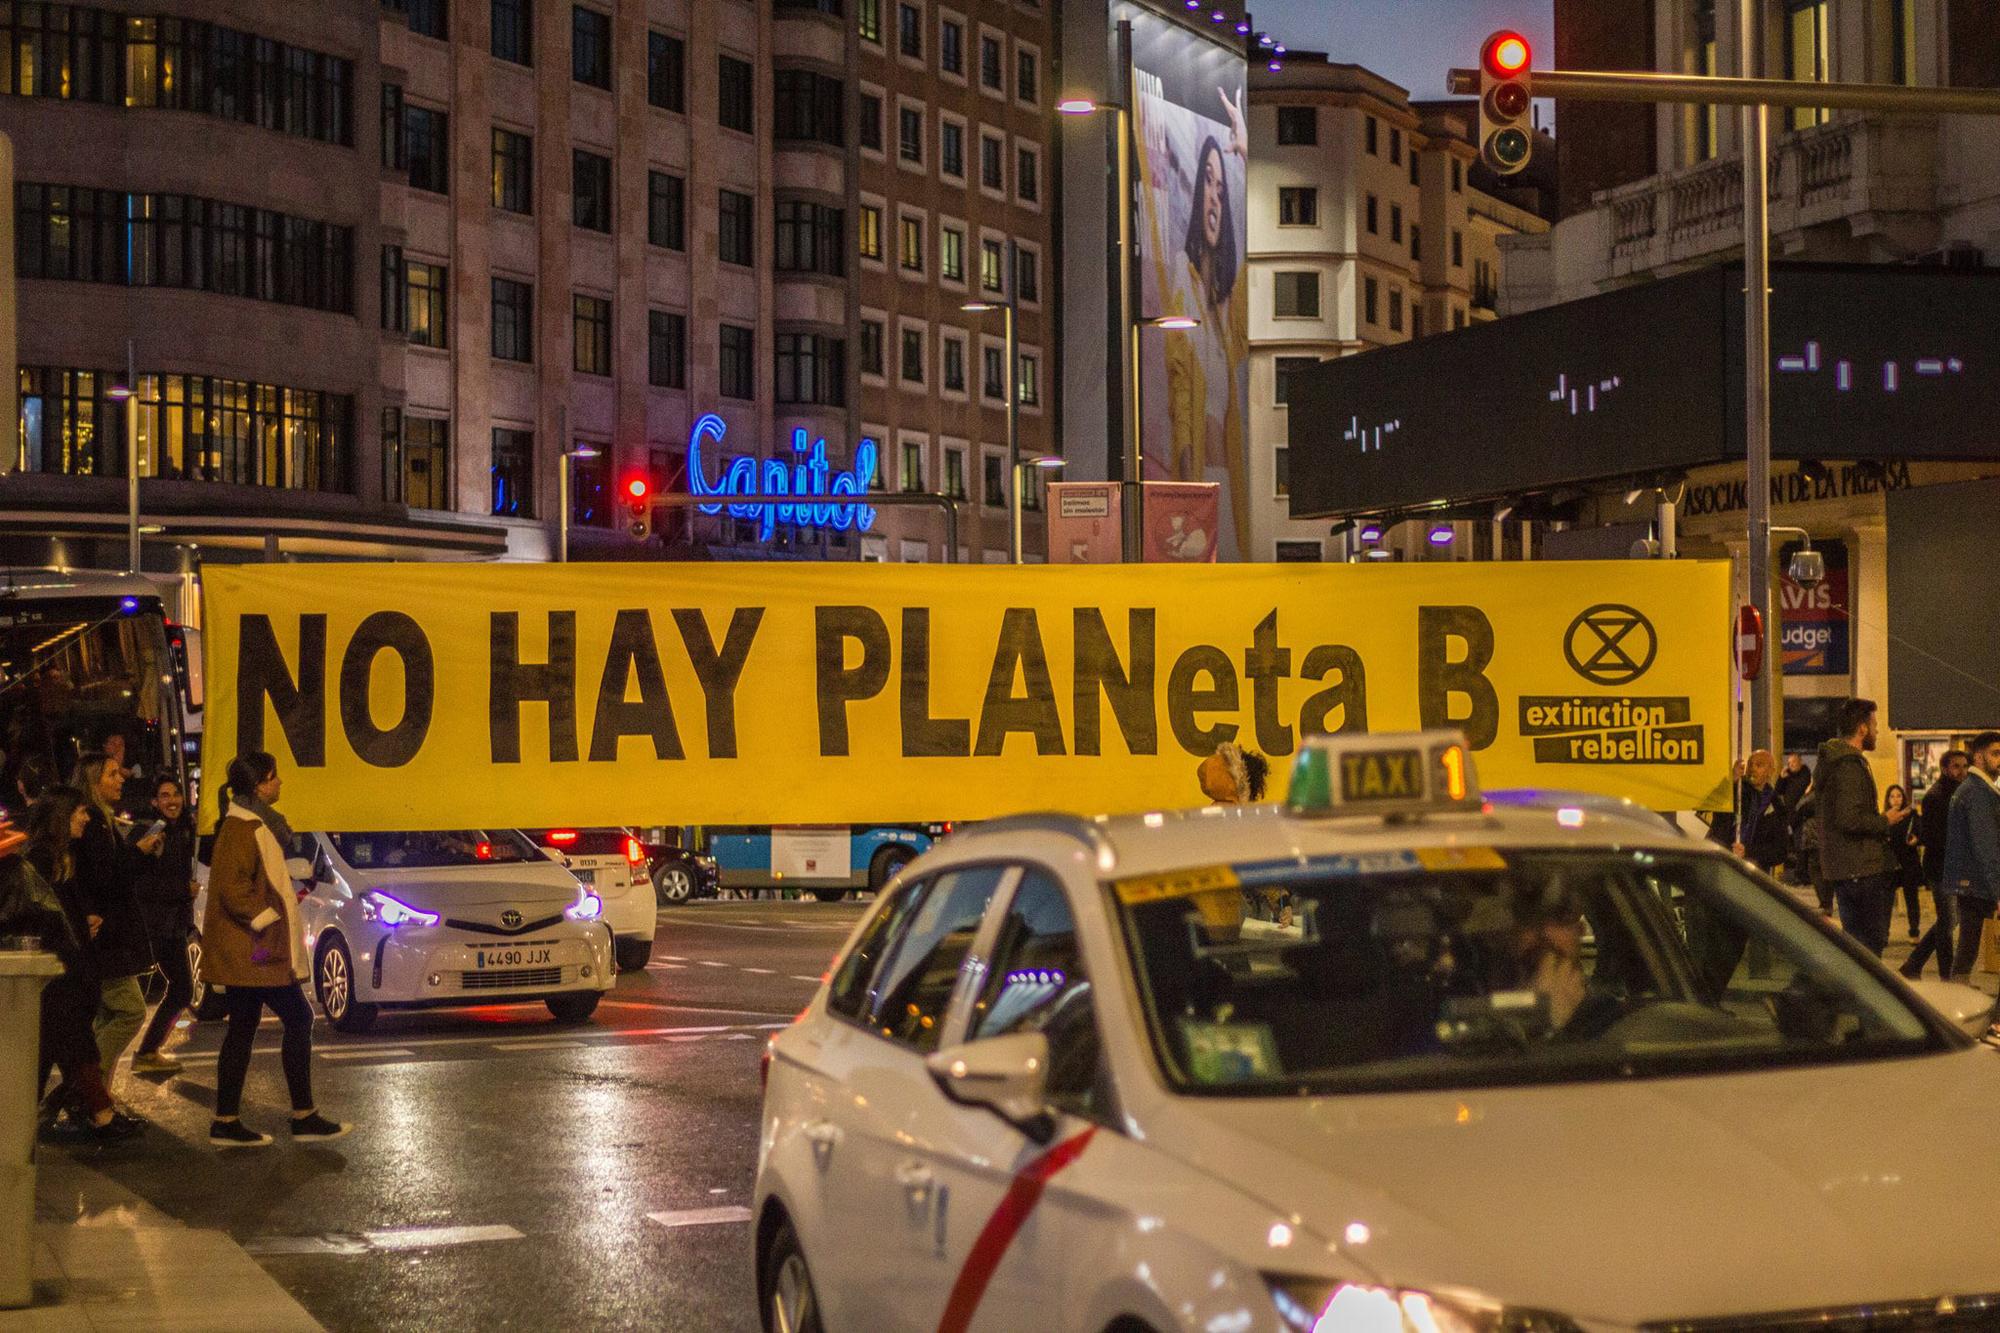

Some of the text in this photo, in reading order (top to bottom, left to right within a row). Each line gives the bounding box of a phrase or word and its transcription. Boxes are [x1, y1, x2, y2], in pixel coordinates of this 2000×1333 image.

[687, 413, 878, 543] Capitol
[1781, 626, 1831, 650] udget
[236, 605, 1500, 769] NO HAY PLANeta B
[1526, 699, 1666, 727] extinction
[1570, 728, 1698, 761] rebellion
[1344, 754, 1420, 796] TAXI
[1441, 744, 1466, 800] 1
[488, 949, 551, 967] 4490 JJX
